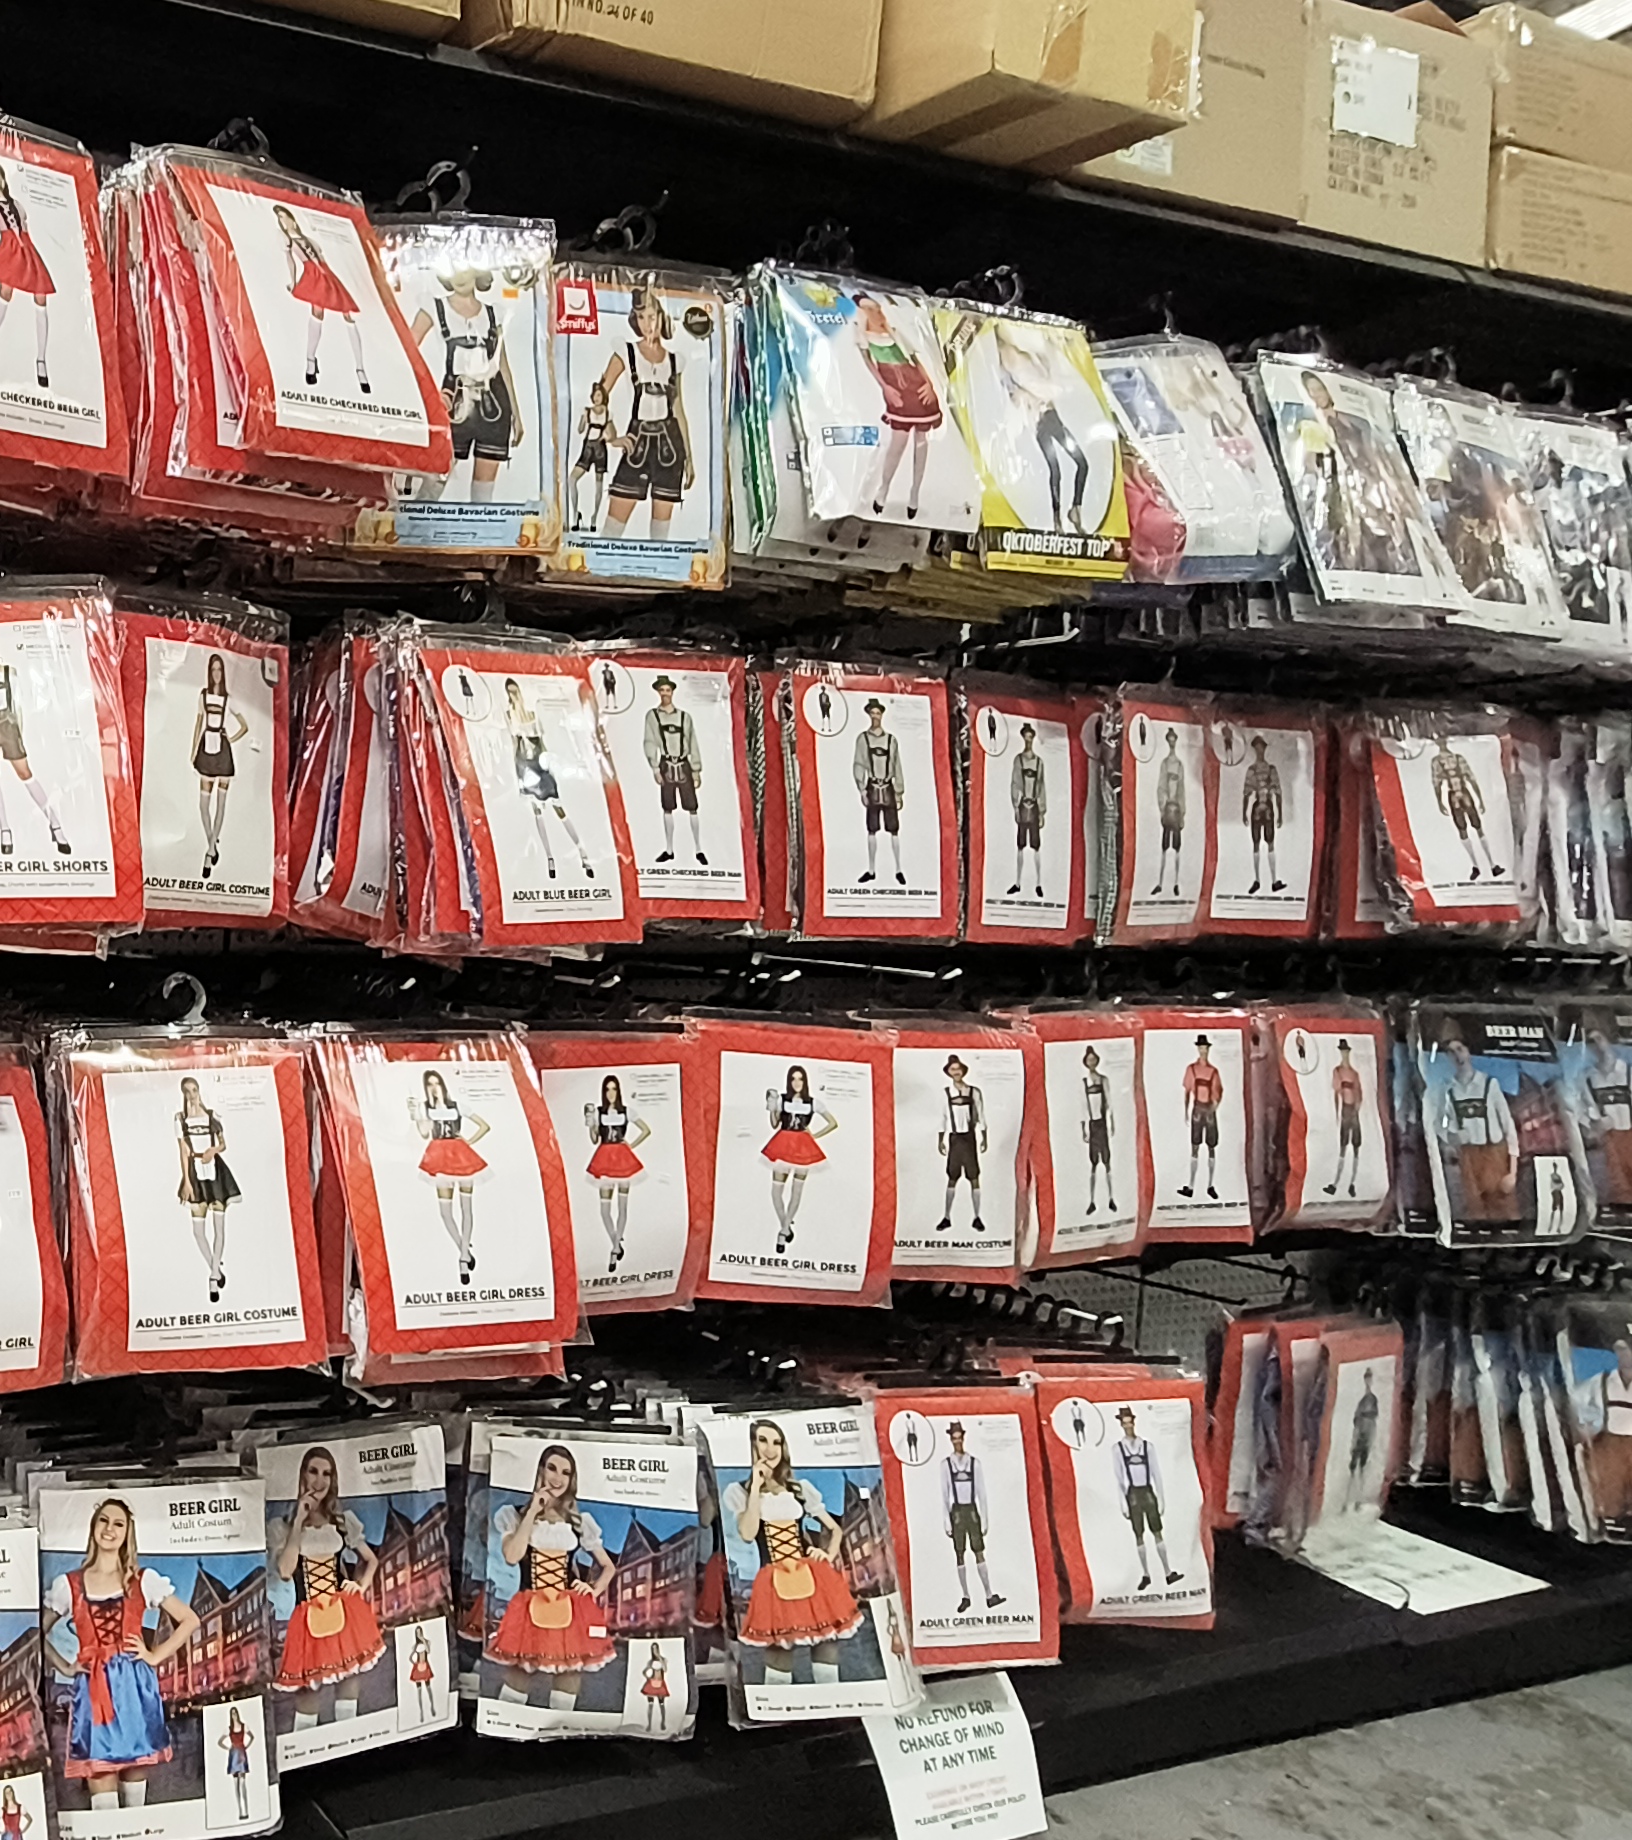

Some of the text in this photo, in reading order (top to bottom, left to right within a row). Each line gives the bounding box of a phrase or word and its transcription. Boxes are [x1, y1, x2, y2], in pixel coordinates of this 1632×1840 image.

[623, 5, 654, 25] OF 40
[0, 391, 55, 410] CHECKERED
[57, 403, 79, 415] BEER
[81, 408, 101, 420] GIRL
[281, 391, 422, 420] ADULT RED CHECKERED BEER GIRL
[427, 506, 539, 516] Deluxe Bavarian Costume
[568, 541, 708, 554] Traditional Deluxe Bavarian Costume
[1002, 530, 1113, 558] OKTOBERFEST TOP
[17, 860, 49, 872] GIRL
[53, 860, 109, 872] SHORTS
[143, 877, 270, 896] ADULT BEER GIRL COSTUME
[512, 888, 612, 901] ADULT BLUE BEER GIRL
[925, 1240, 948, 1248] BEER
[951, 1241, 973, 1249] MAN
[719, 1254, 857, 1273] ADULT BEER GIRL DRESS
[592, 1269, 673, 1287] BEER GIRL DRESS
[404, 1286, 545, 1305] ADULT BEER GIRL DRESS
[135, 1306, 298, 1329] ADULT BEER GIRL COSTUME
[5, 1337, 34, 1348] GIRL
[806, 1422, 838, 1436] BEER
[358, 1443, 418, 1463] BEER GIRL
[602, 1458, 669, 1473] BEER GIRL
[169, 1498, 242, 1517] BEER GIRL
[170, 1518, 232, 1531] Adult Costum
[919, 1614, 1034, 1629] ADULT GREEN BEER MAN
[893, 1700, 995, 1731] NO REFUND FOR
[899, 1721, 1005, 1754] CHANGE OF MIND
[923, 1745, 998, 1774] AT ANY TIME
